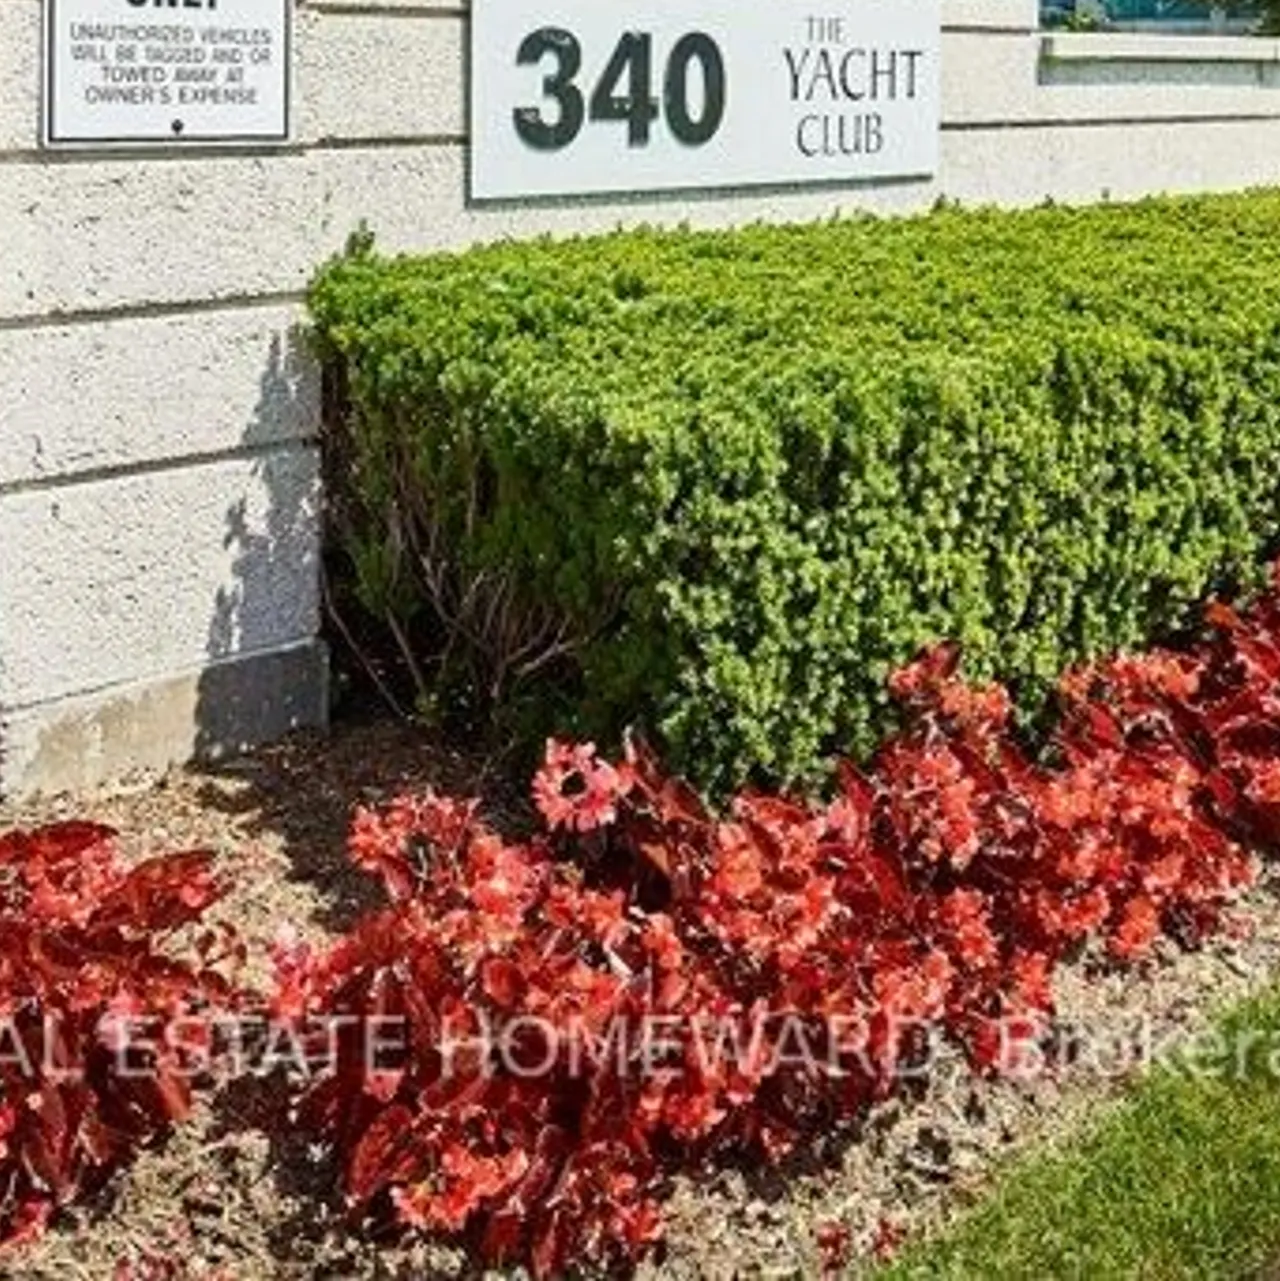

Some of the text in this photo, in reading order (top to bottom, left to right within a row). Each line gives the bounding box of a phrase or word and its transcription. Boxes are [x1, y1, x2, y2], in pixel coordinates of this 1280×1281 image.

[70, 23, 272, 45] UNAUTHORIZED VEHICLES
[805, 16, 842, 43] THE
[512, 25, 726, 153] 340
[784, 49, 922, 101] YACHT
[178, 87, 258, 105] EXPENSE
[796, 114, 884, 157] CLUB
